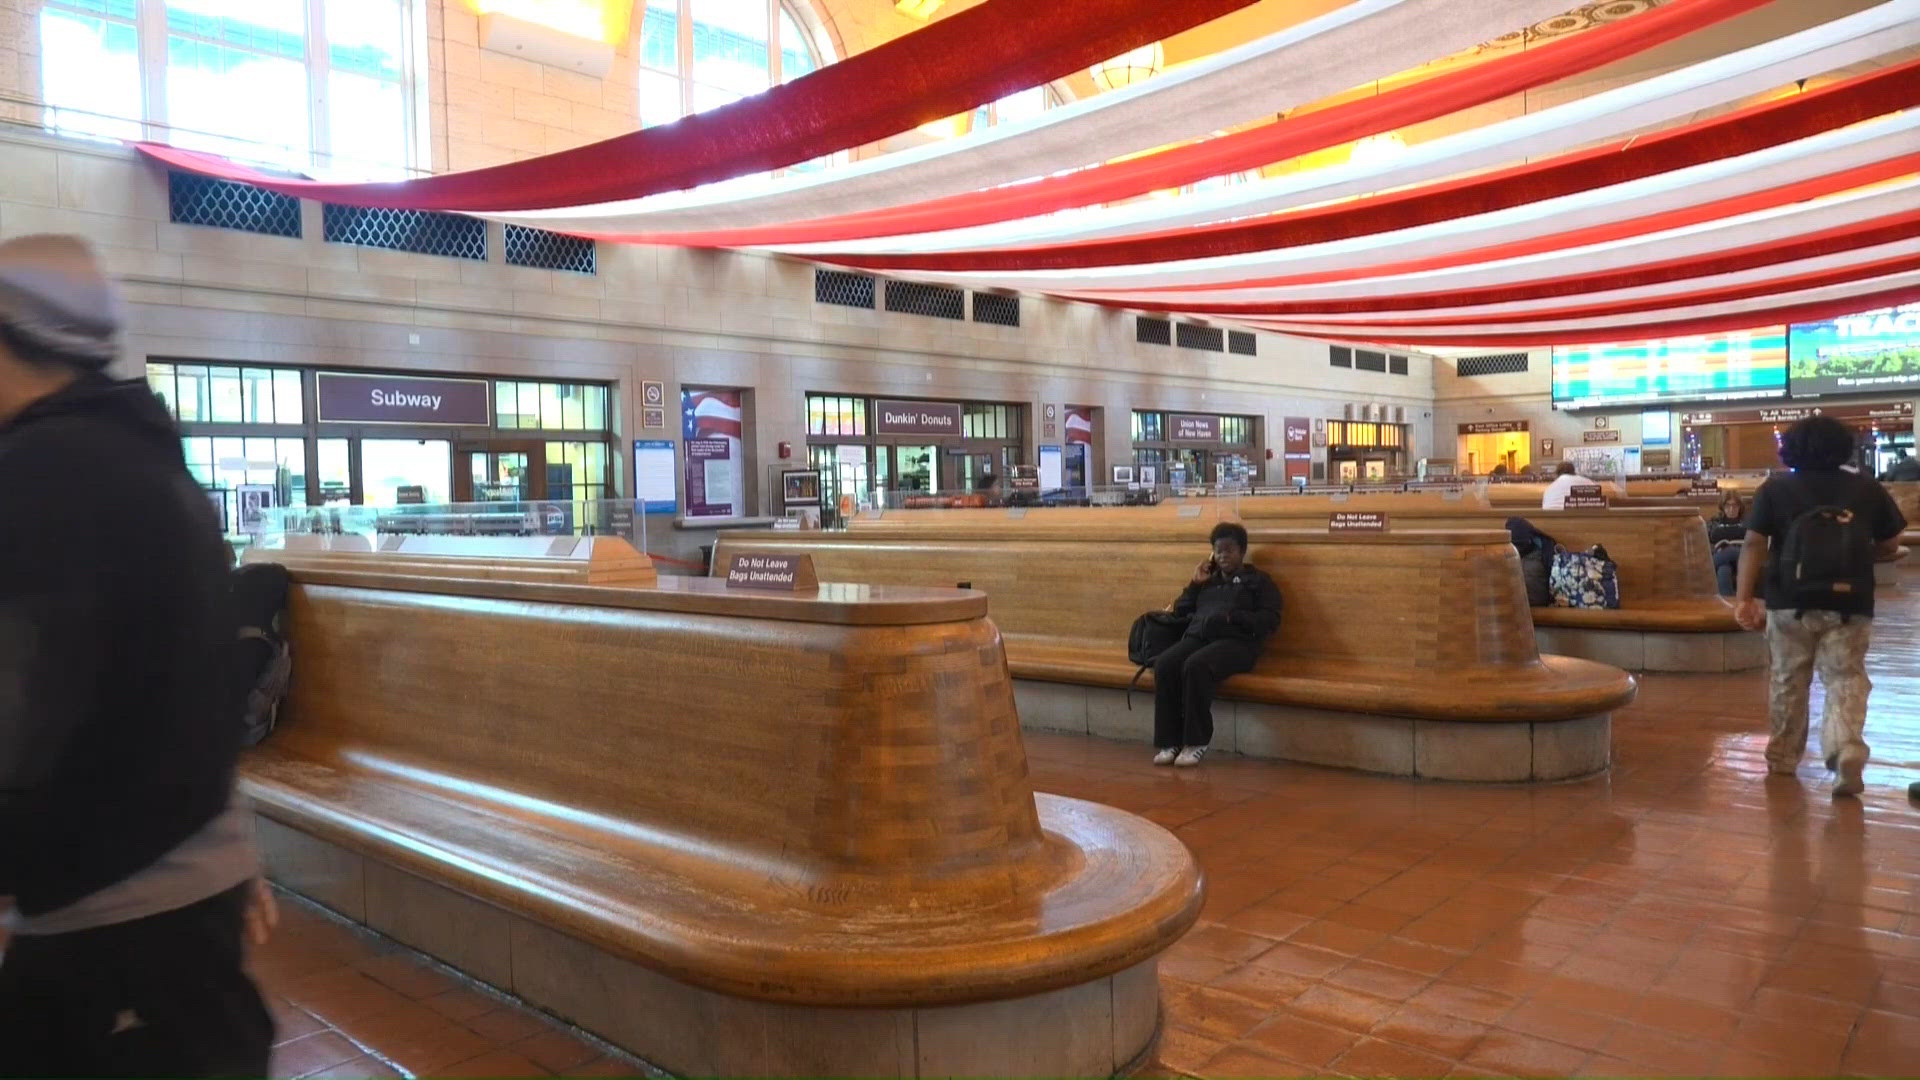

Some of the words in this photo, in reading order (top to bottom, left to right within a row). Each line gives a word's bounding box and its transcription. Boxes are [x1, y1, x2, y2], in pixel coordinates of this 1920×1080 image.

[371, 388, 442, 410] Subway
[885, 411, 918, 425] Dunkin'
[921, 413, 952, 426] Donuts
[1181, 419, 1195, 428] Union
[1196, 420, 1209, 429] News
[1178, 429, 1184, 437] of
[1185, 429, 1196, 437] New
[1197, 430, 1212, 438] Haven
[1330, 520, 1346, 528] Bags
[1347, 520, 1382, 528] Unattended
[739, 557, 749, 568] Do
[751, 558, 764, 568] Not
[766, 558, 788, 569] Leave
[729, 570, 748, 582] Bags
[750, 570, 793, 582] Unattended
